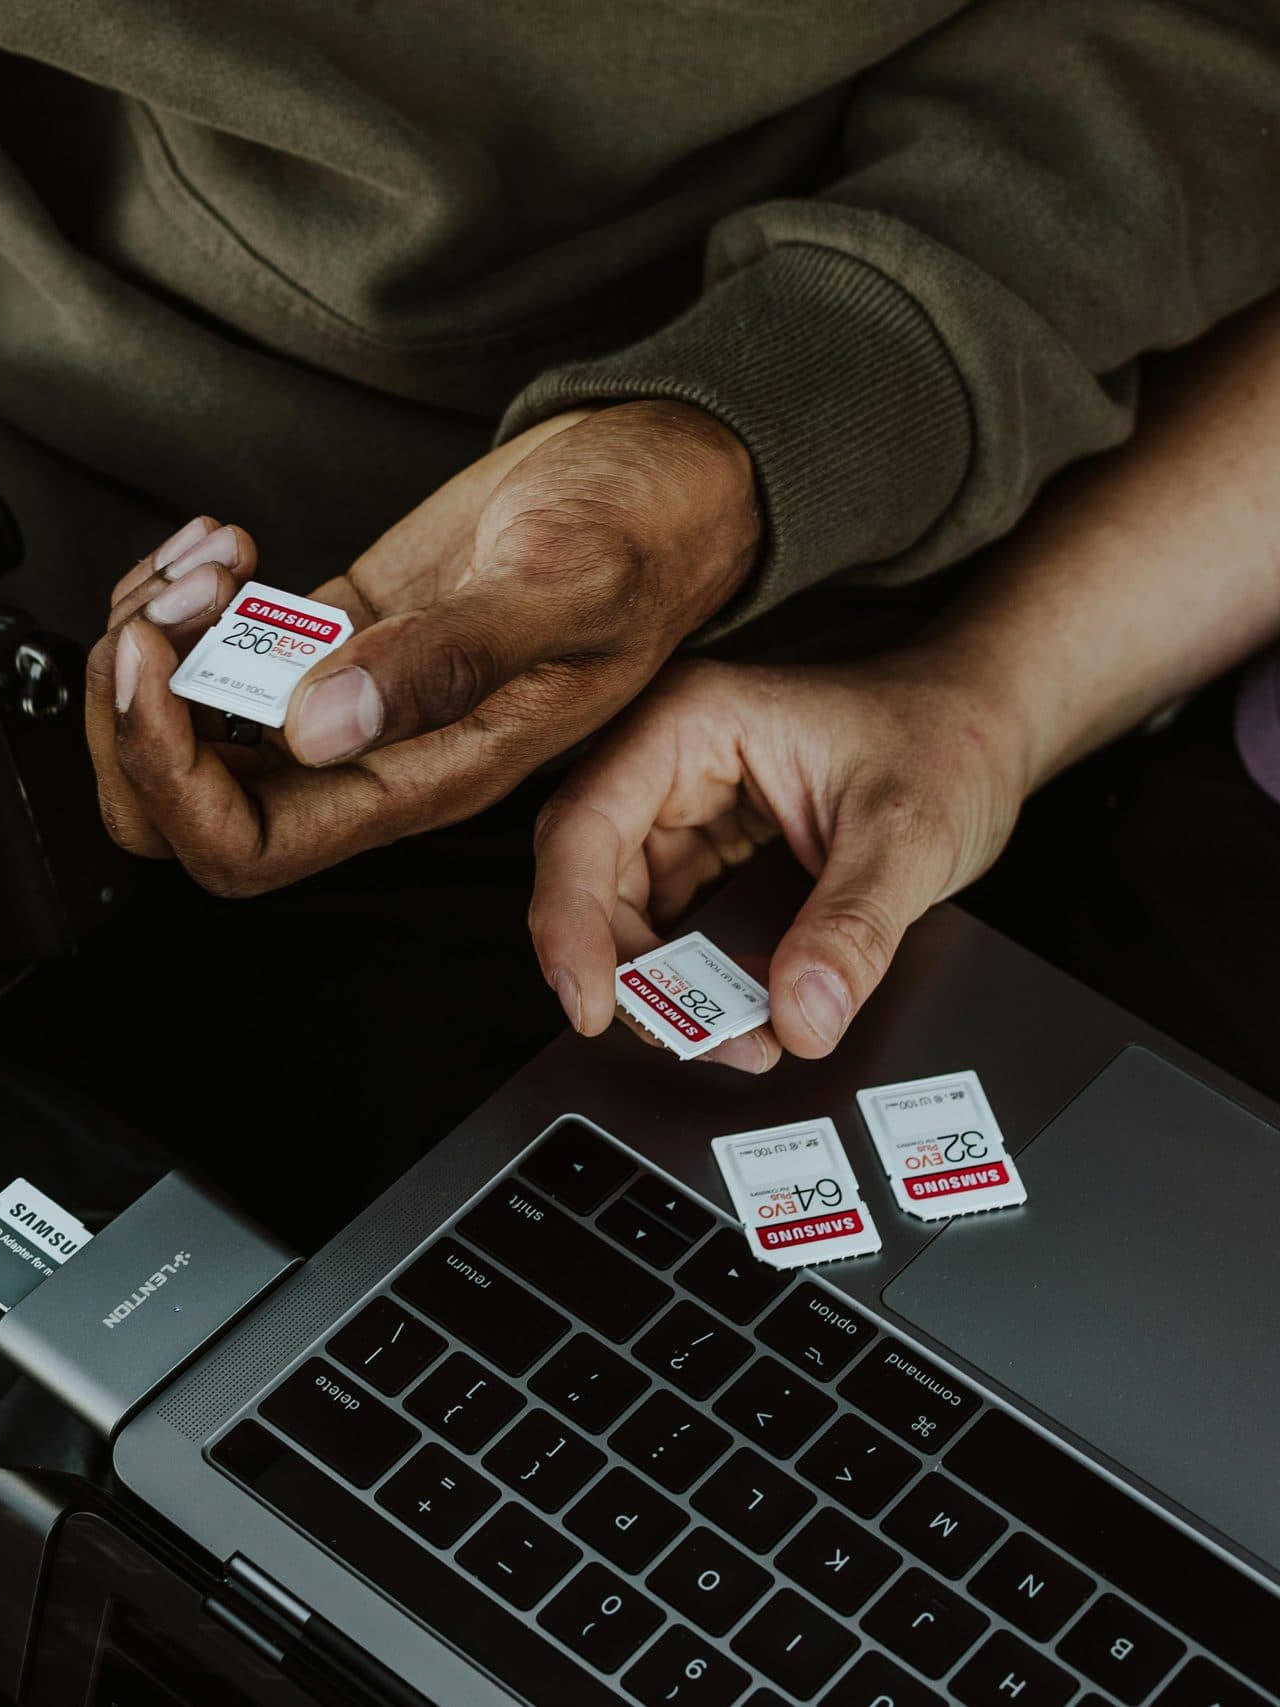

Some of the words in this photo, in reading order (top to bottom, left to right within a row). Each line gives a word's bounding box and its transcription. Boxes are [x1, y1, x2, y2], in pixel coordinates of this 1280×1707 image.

[246, 602, 333, 636] SAMSUNG
[222, 622, 278, 654] 256
[277, 635, 316, 655] EVO
[648, 968, 683, 995] EVO
[628, 977, 698, 1036] SAMSUNG
[679, 989, 727, 1025] 128
[937, 1130, 988, 1163] 32
[905, 1152, 944, 1170] EVO
[792, 1178, 842, 1212] 64
[912, 1169, 1001, 1196] SAMSUNG
[508, 1195, 545, 1222] shift
[758, 1200, 798, 1219] EVO
[770, 1192, 793, 1201] Plus
[9, 1203, 77, 1256] SAMSU
[767, 1217, 855, 1244] SAMSUNG
[2, 1235, 33, 1262] Adapter
[30, 1256, 46, 1270] for
[446, 1254, 493, 1289] return
[102, 1263, 177, 1328] LENTION
[809, 1299, 858, 1335] option
[670, 1352, 690, 1370] ?
[884, 1352, 961, 1406] command
[315, 1375, 360, 1411] delete
[748, 1488, 765, 1510] L
[615, 1514, 638, 1530] P
[929, 1512, 959, 1537] M
[825, 1548, 850, 1572] K
[697, 1570, 720, 1591] O
[1017, 1573, 1045, 1599] N
[601, 1595, 622, 1615] 0
[912, 1612, 935, 1628] J
[1110, 1638, 1135, 1661] B
[685, 1658, 708, 1680] 9
[998, 1672, 1027, 1698] H
